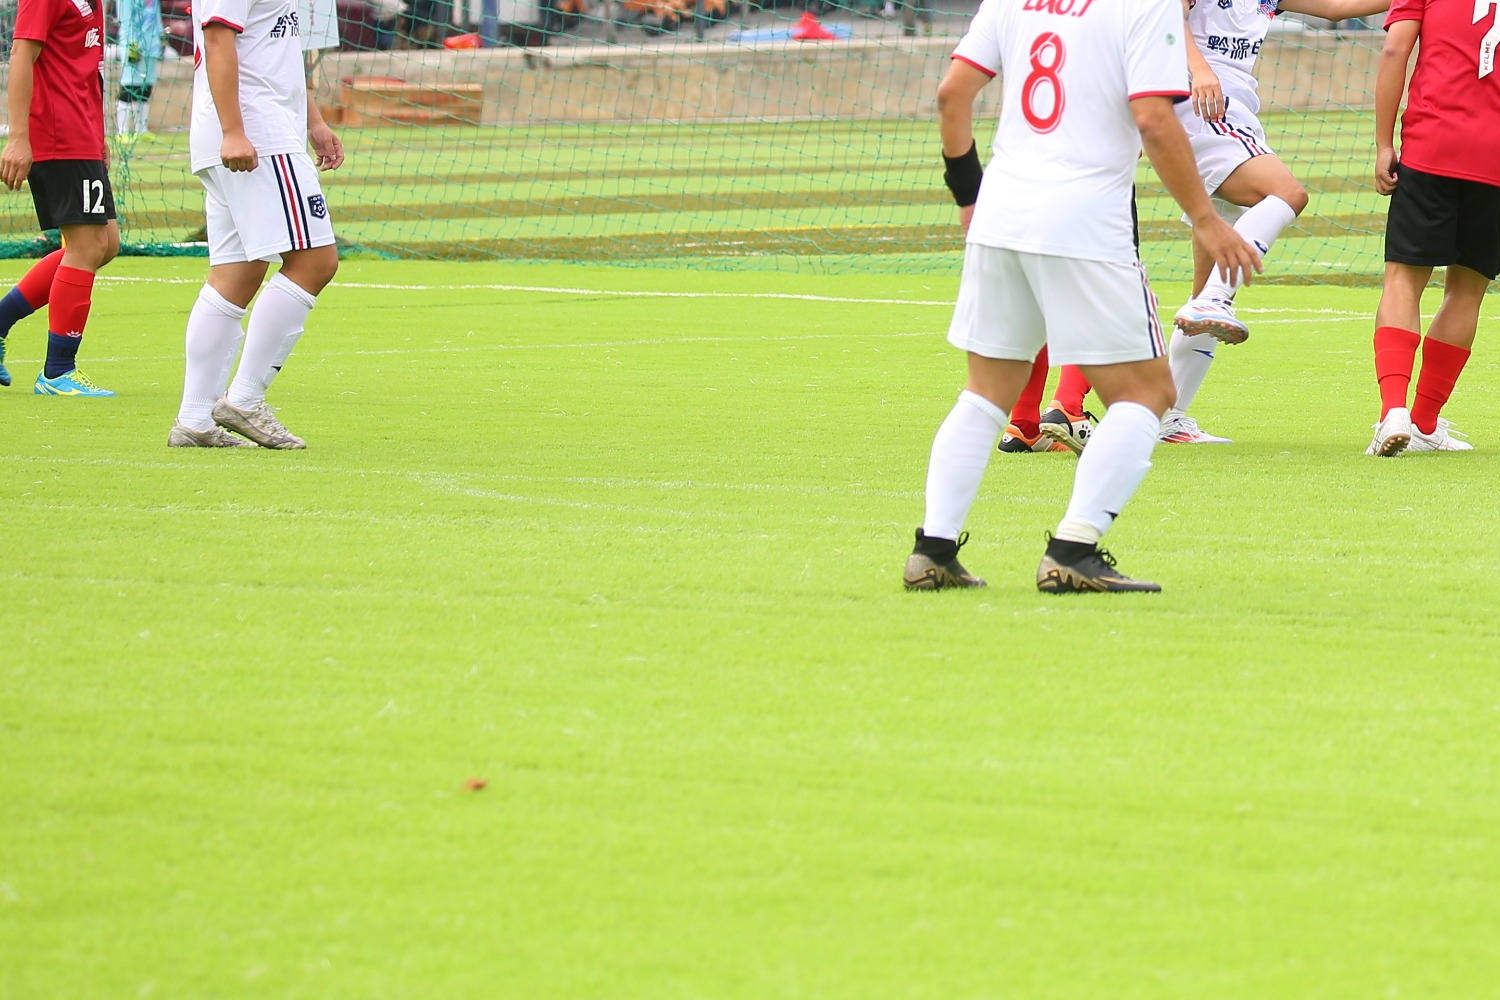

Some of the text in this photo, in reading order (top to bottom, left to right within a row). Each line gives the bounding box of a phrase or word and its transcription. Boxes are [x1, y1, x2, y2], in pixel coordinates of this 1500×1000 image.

[1483, 40, 1492, 71] KELME
[1021, 31, 1067, 135] 8
[83, 179, 105, 214] 12
